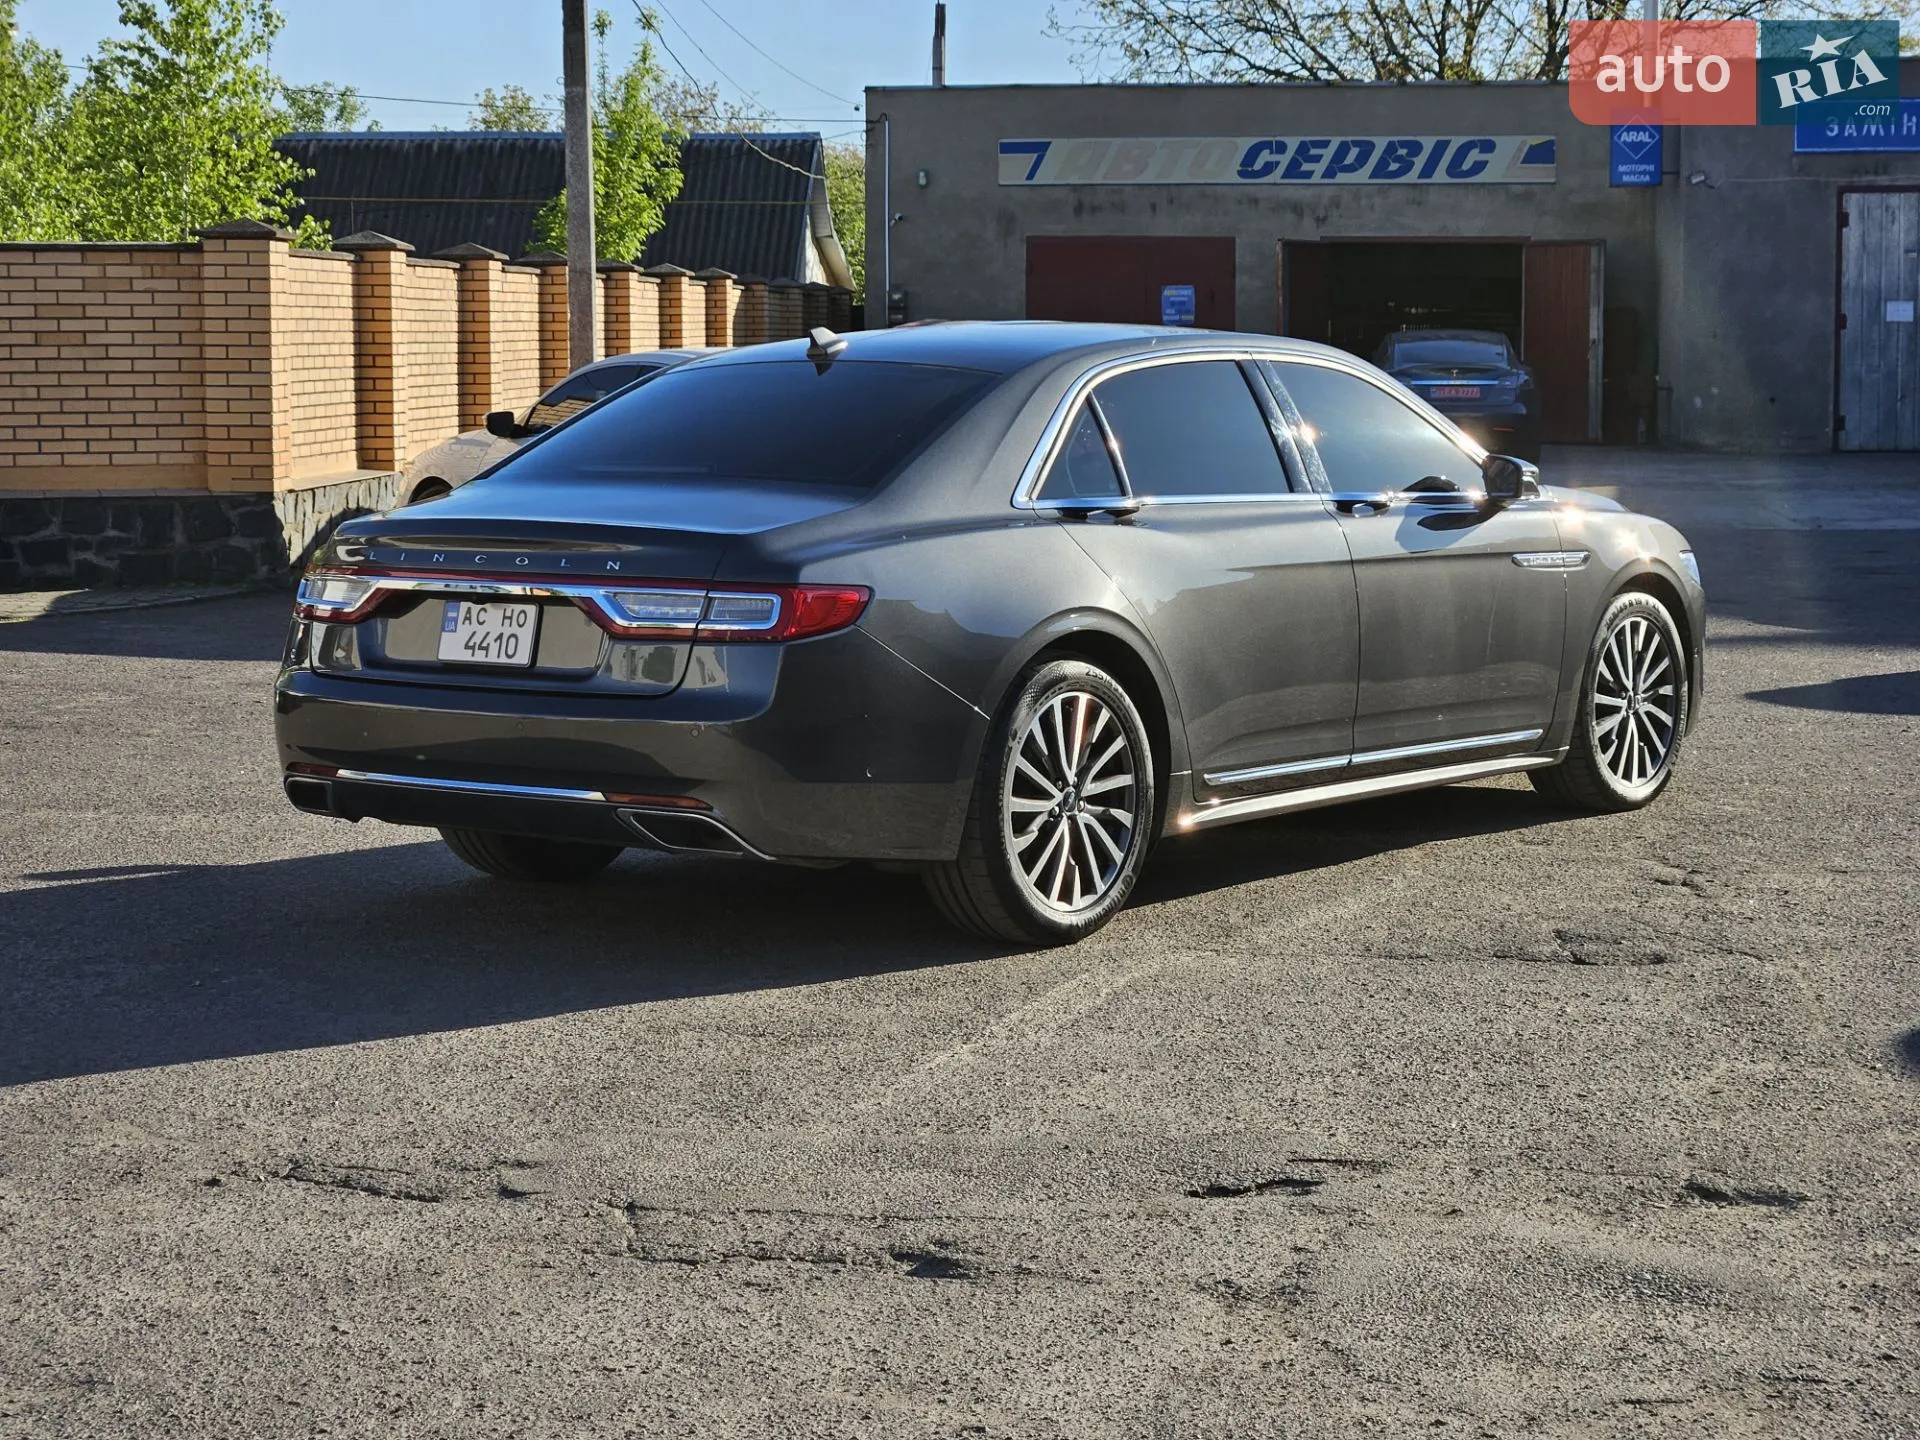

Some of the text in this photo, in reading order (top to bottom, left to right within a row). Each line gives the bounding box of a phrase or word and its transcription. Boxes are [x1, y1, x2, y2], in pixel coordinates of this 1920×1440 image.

[1620, 131, 1652, 142] ARAL
[368, 553, 621, 571] LINCOLN
[462, 606, 488, 626] AC
[463, 630, 519, 660] 4410
